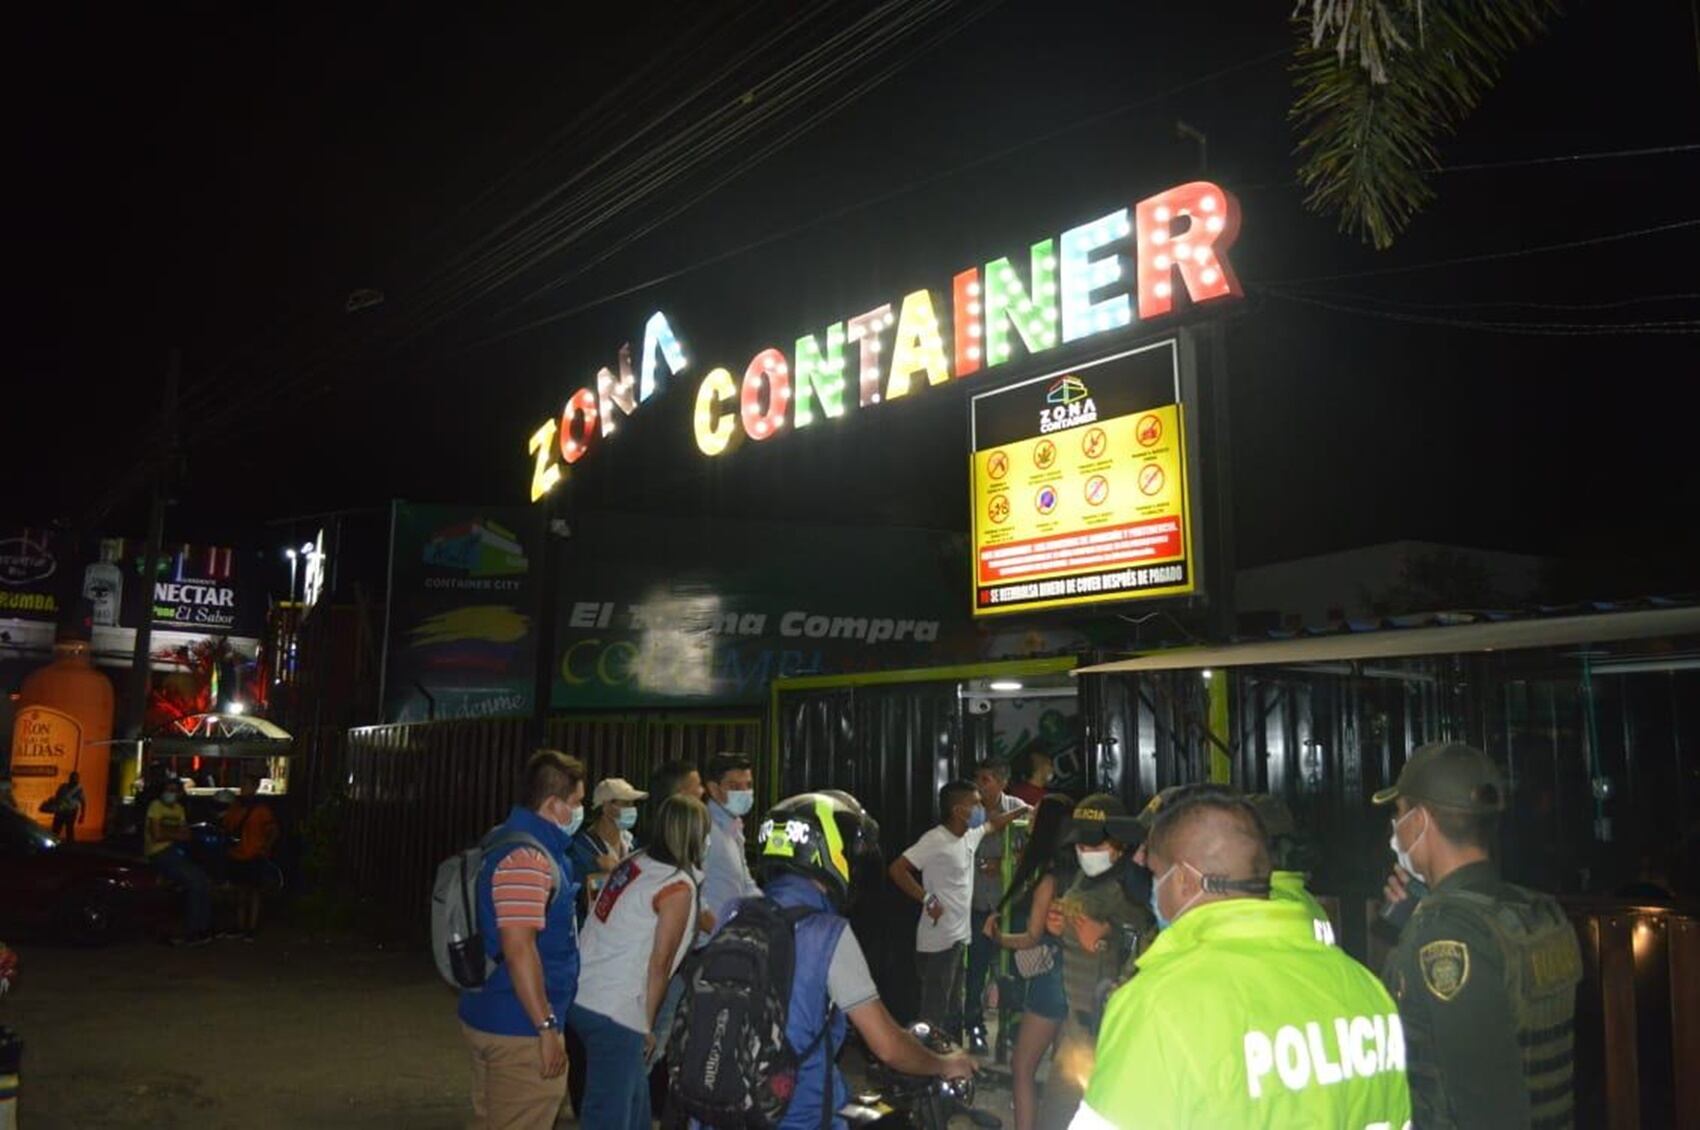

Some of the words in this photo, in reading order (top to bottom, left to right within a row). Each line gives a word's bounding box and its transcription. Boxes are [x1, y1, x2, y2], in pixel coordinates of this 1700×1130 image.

[530, 311, 687, 503] ZONA
[694, 180, 1242, 457] CONTAINER
[1040, 398, 1096, 423] ZONA
[1040, 412, 1097, 433] CONTAINER
[154, 582, 234, 607] NECTAR
[424, 577, 491, 590] CONTAINER
[494, 578, 520, 591] CITY
[195, 606, 235, 623] Sabor
[568, 602, 615, 628] El
[779, 610, 940, 645] Compra
[1244, 1013, 1407, 1099] POLICIA
